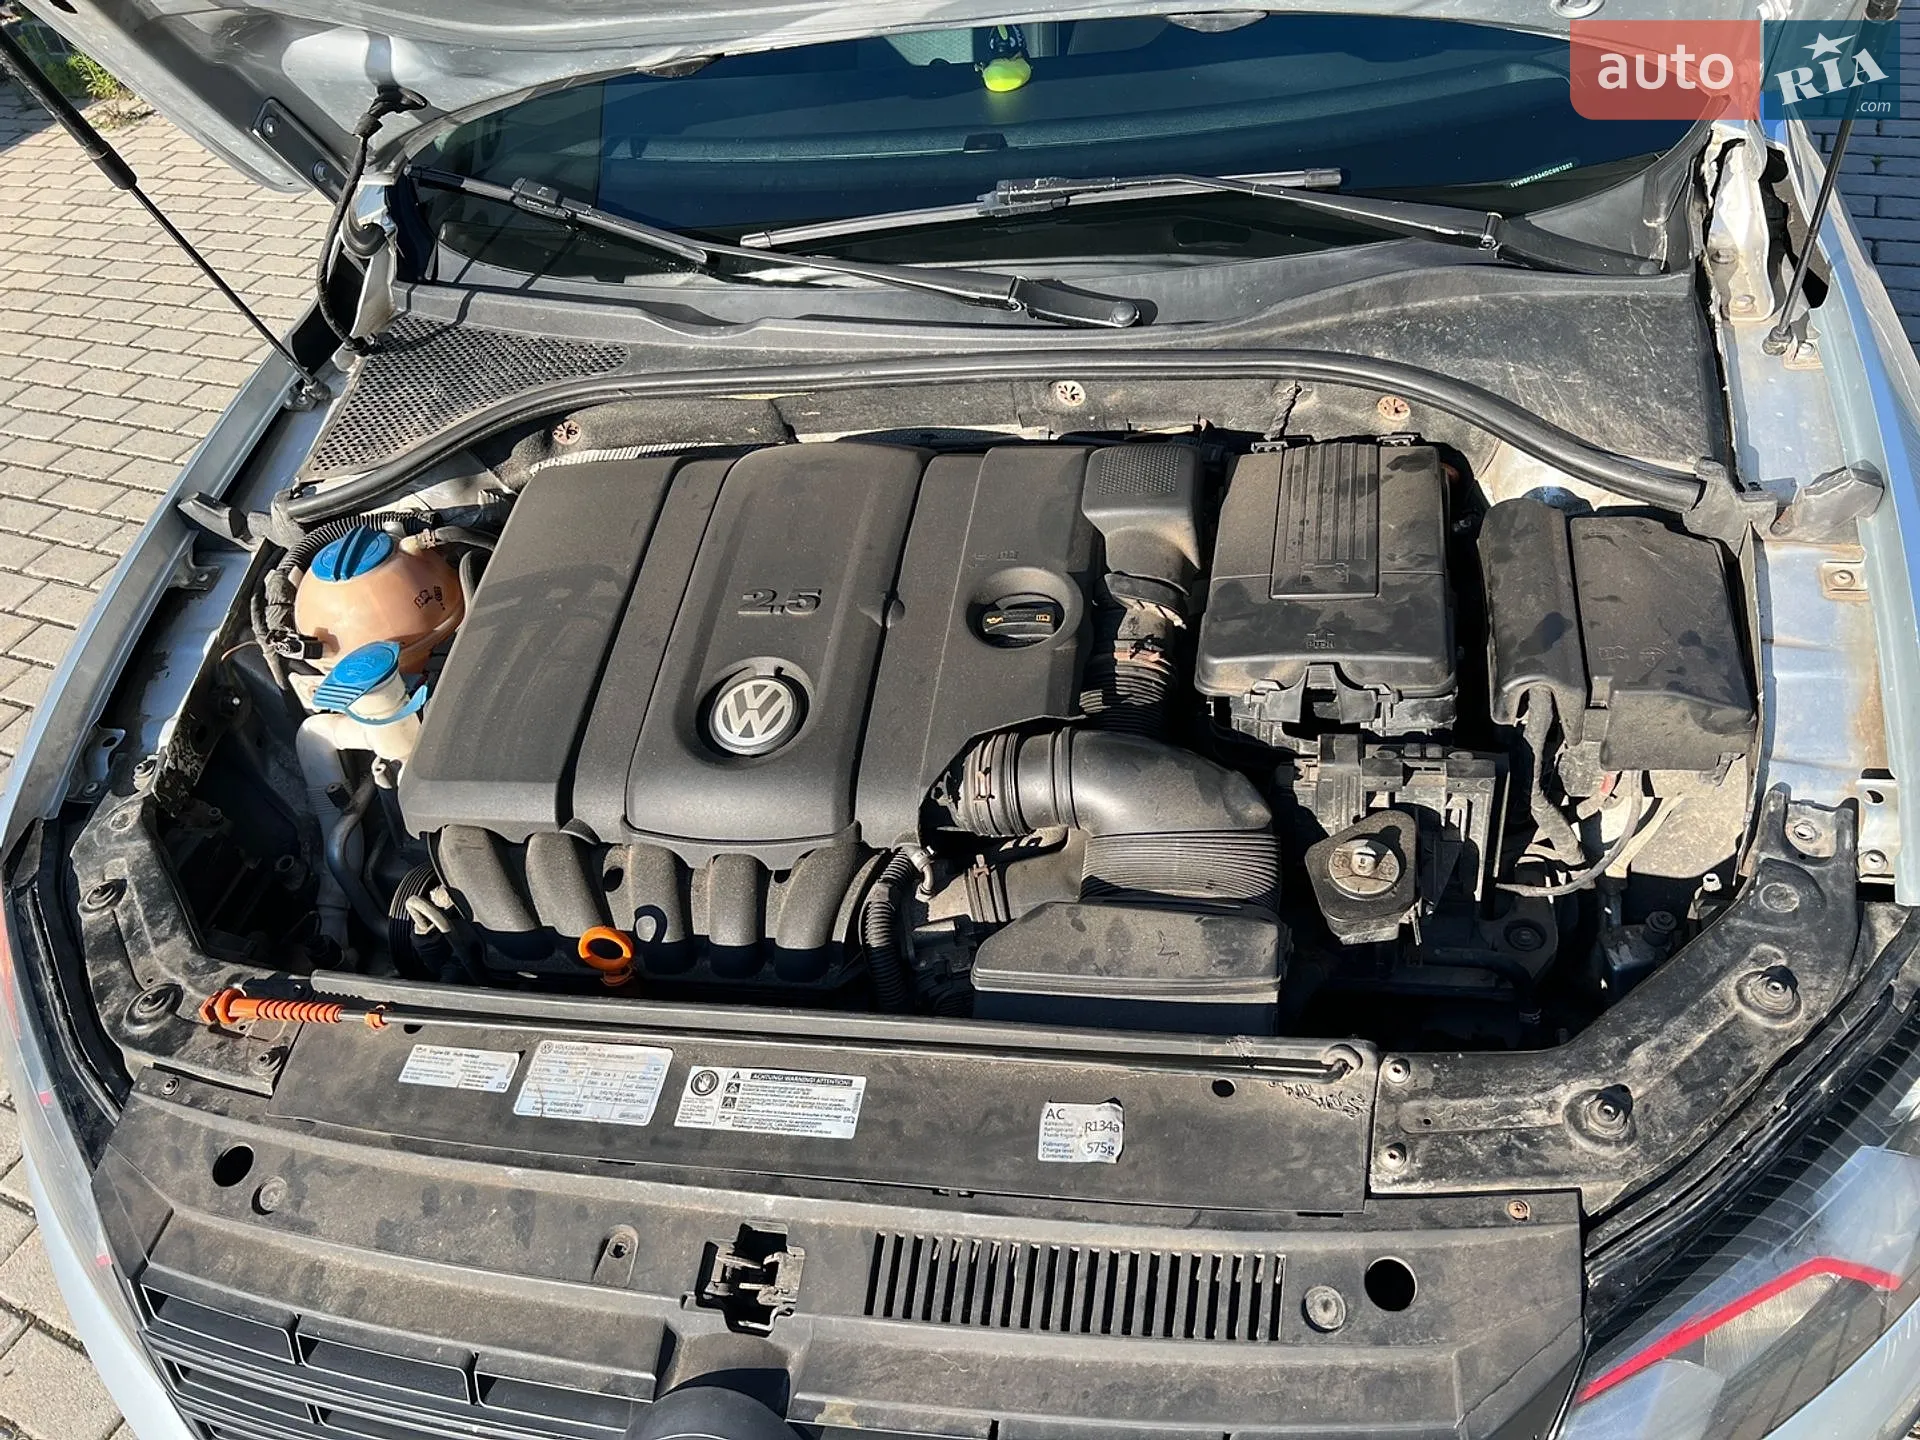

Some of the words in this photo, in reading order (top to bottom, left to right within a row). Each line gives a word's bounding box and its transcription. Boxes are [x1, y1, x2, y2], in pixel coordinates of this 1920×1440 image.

[717, 681, 791, 743] VW
[1045, 1108, 1065, 1120] AC
[1085, 1120, 1120, 1133] R134a
